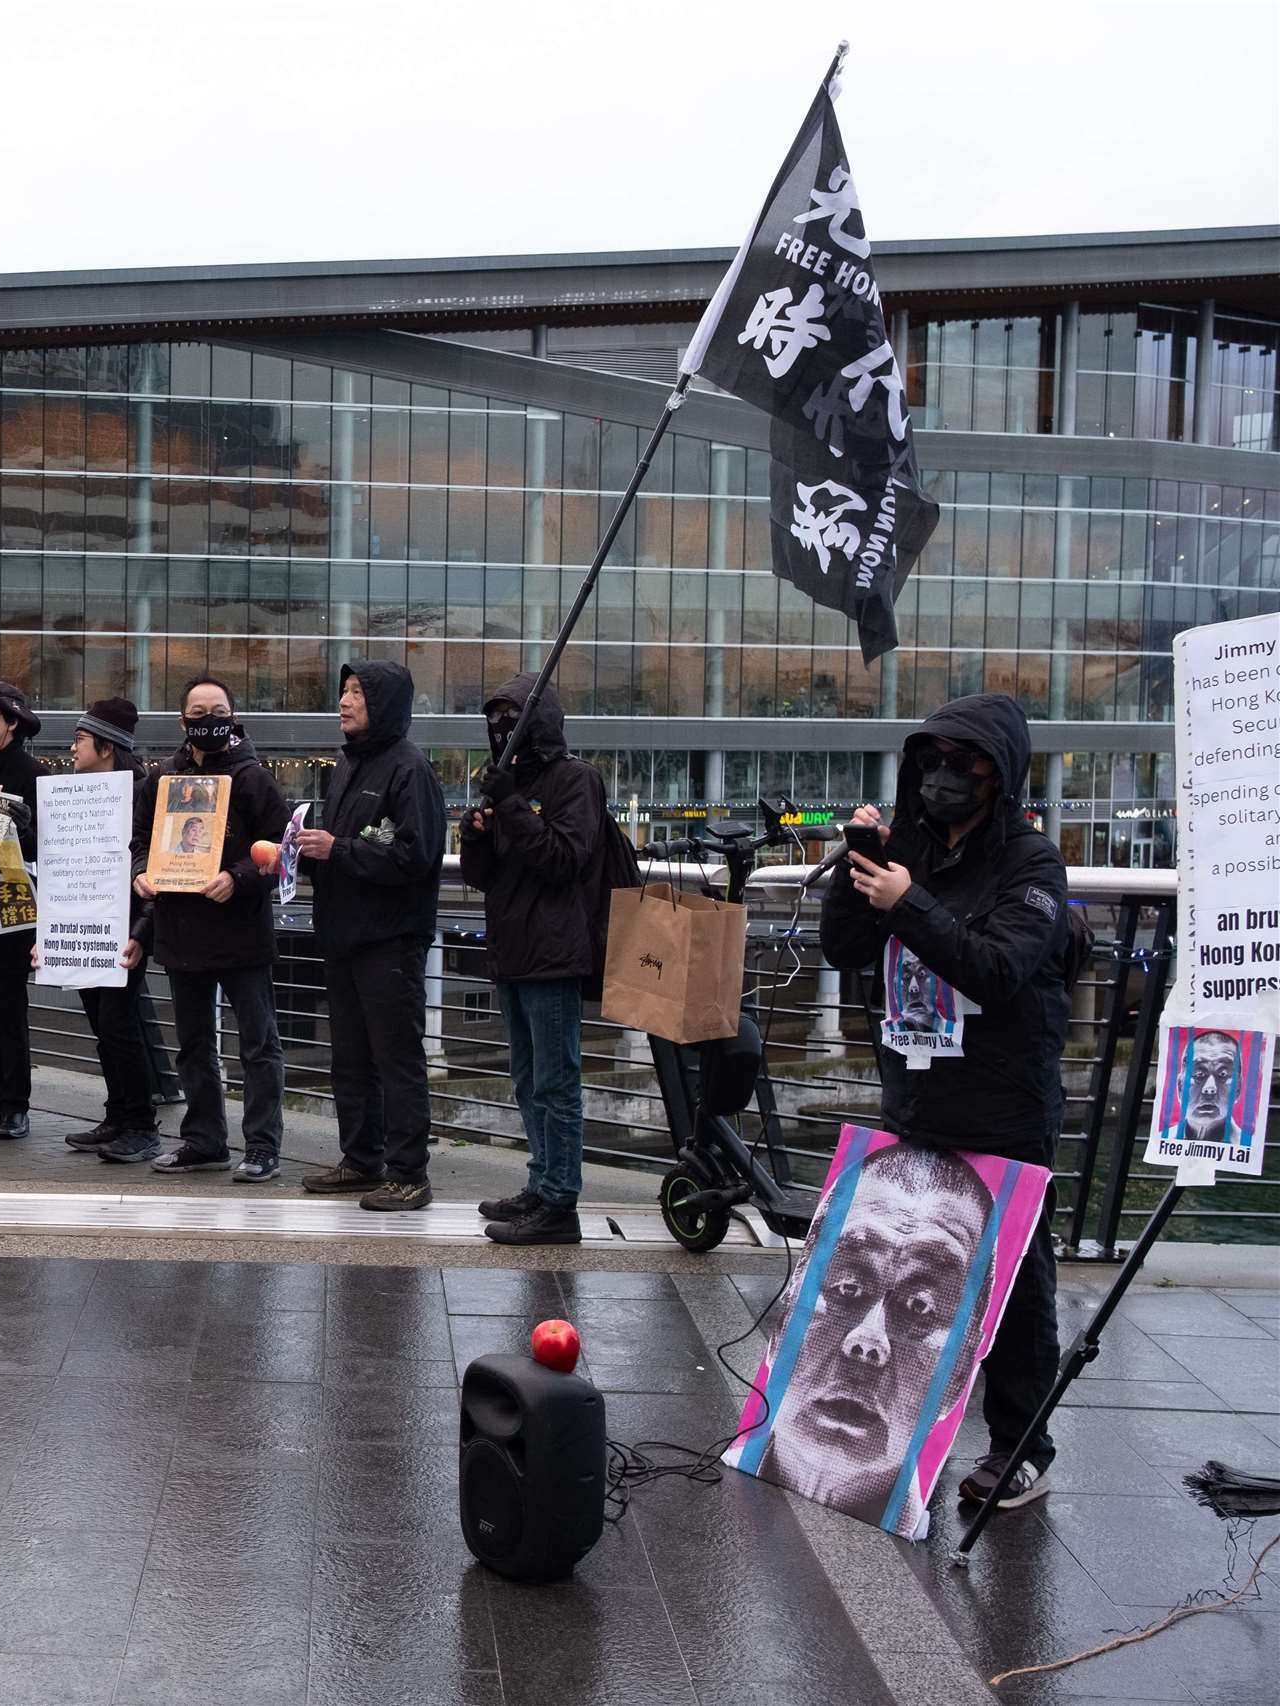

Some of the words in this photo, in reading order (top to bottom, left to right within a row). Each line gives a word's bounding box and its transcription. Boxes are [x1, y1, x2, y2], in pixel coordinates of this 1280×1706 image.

[774, 232, 833, 277] FREE
[1214, 640, 1276, 661] Jimmy
[1192, 675, 1219, 691] has
[1225, 666, 1271, 684] been
[1212, 693, 1260, 712] Hong
[188, 727, 208, 736] END
[213, 725, 230, 736] CCP
[1232, 718, 1280, 734] Secu
[51, 785, 73, 794] Jimmy
[87, 784, 100, 793] aged
[1193, 785, 1269, 807] spending
[43, 800, 54, 808] has
[55, 799, 72, 807] been
[72, 796, 102, 806] convicted
[103, 794, 122, 803] under
[1219, 808, 1280, 826] solitary
[57, 824, 82, 833] Security
[44, 837, 74, 846] defending
[75, 837, 91, 845] press
[102, 855, 116, 864] days
[1212, 864, 1221, 875] a
[79, 881, 96, 889] facing
[1217, 913, 1239, 931] an
[1247, 908, 1280, 930] bru
[50, 924, 59, 933] an
[60, 923, 78, 933] brutal
[80, 924, 103, 935] symbol
[104, 924, 111, 935] of
[44, 939, 59, 951] Hong
[61, 940, 81, 951] Kong's
[83, 940, 118, 952] systematic
[44, 955, 81, 967] suppression
[83, 957, 90, 967] of
[1200, 944, 1244, 966] Hong
[1203, 977, 1280, 1001] suppres
[891, 1033, 909, 1046] Free
[912, 1032, 936, 1049] Jimmy
[939, 1034, 954, 1047] Lai
[1159, 1140, 1182, 1156] Free
[1185, 1142, 1225, 1161] Jimmy
[1229, 1147, 1250, 1163] Lai
